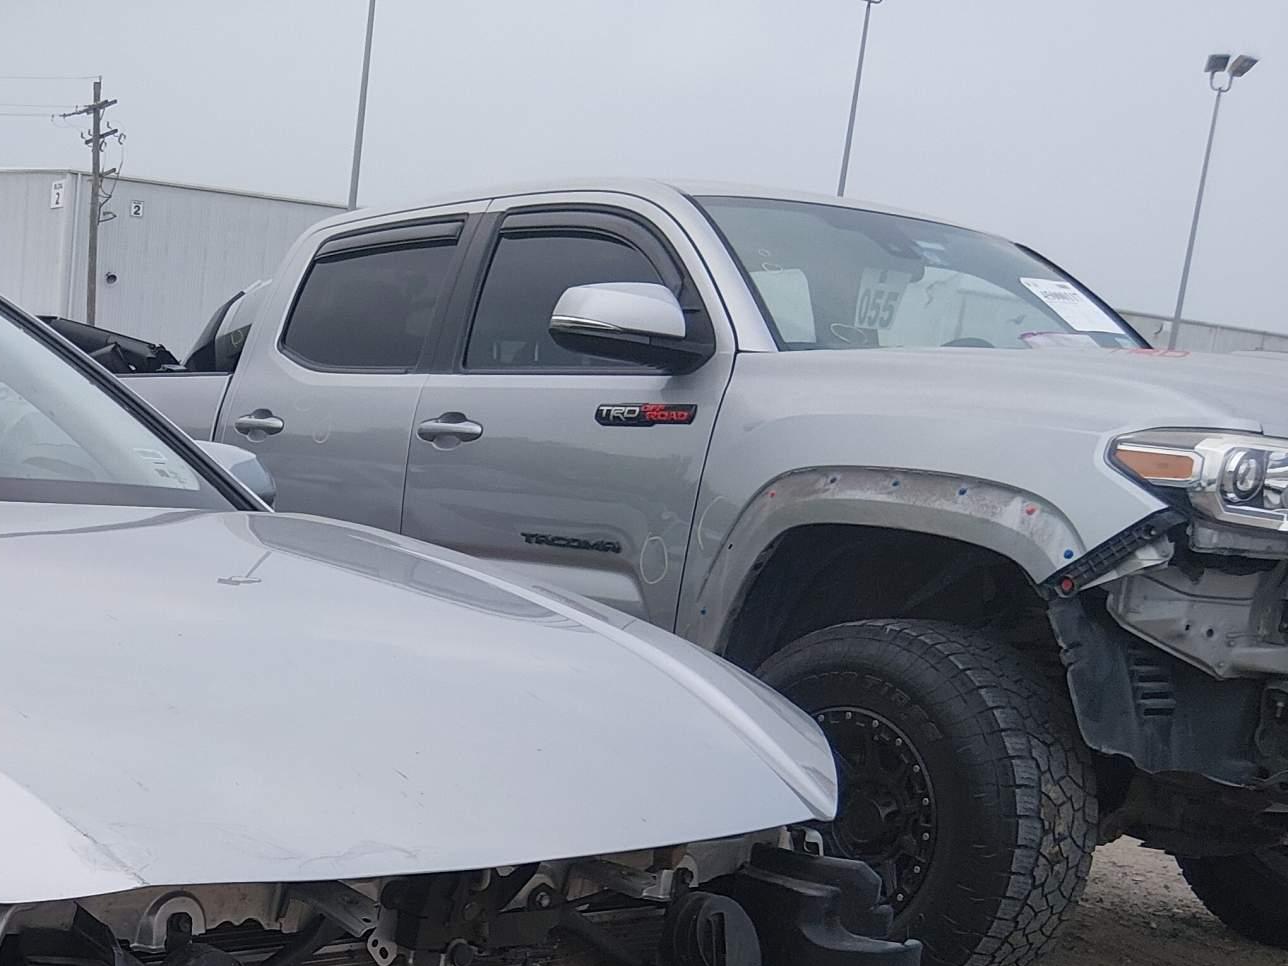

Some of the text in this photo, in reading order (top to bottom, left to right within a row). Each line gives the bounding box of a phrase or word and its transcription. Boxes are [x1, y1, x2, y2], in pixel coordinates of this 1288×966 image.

[133, 204, 141, 215] 2
[857, 288, 900, 328] 055
[598, 405, 640, 421] TRD
[646, 411, 689, 421] ROAD
[520, 532, 622, 554] TACOMA
